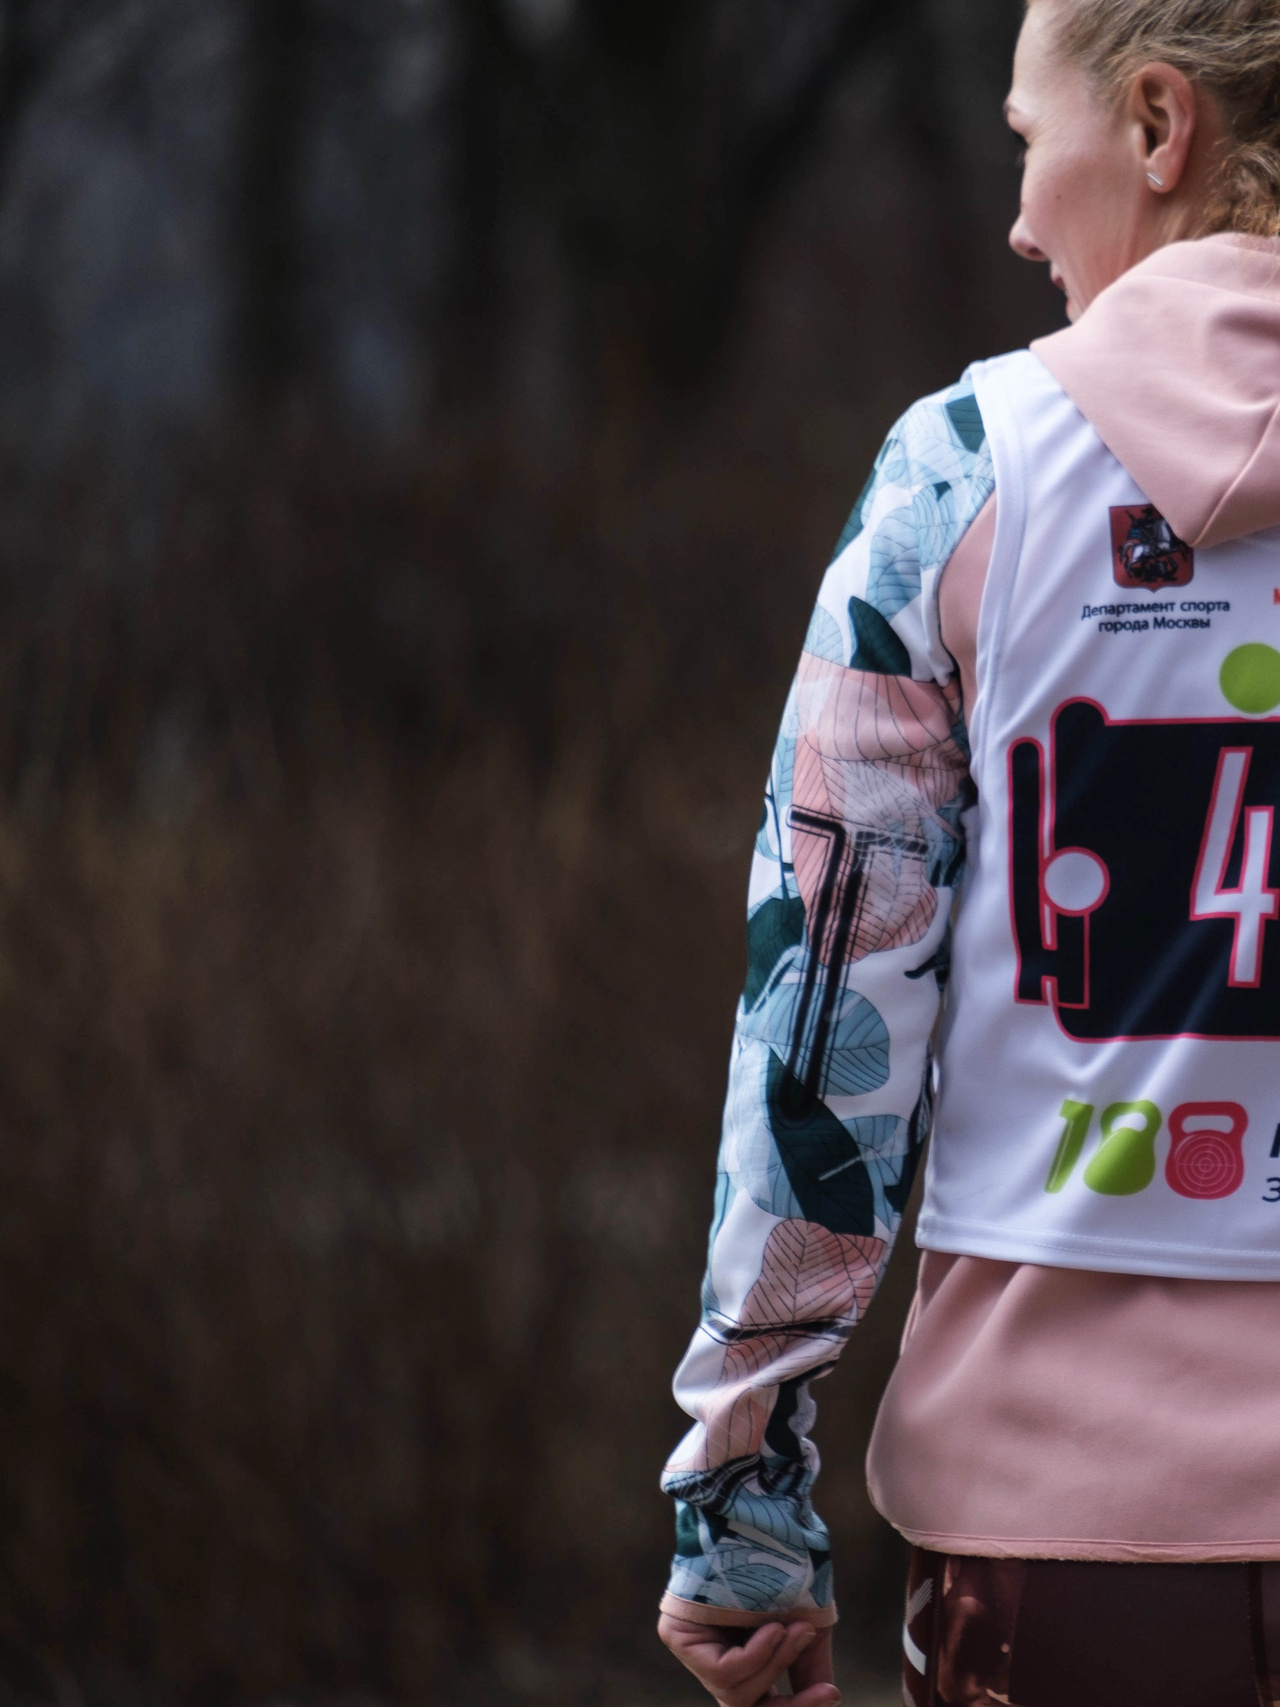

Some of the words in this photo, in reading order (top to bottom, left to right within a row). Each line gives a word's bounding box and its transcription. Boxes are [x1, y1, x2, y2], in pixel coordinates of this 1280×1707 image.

[1081, 601, 1176, 620] Департамент
[1180, 600, 1230, 615] спорта
[1098, 609, 1149, 634] города
[1153, 606, 1211, 629] Москвы
